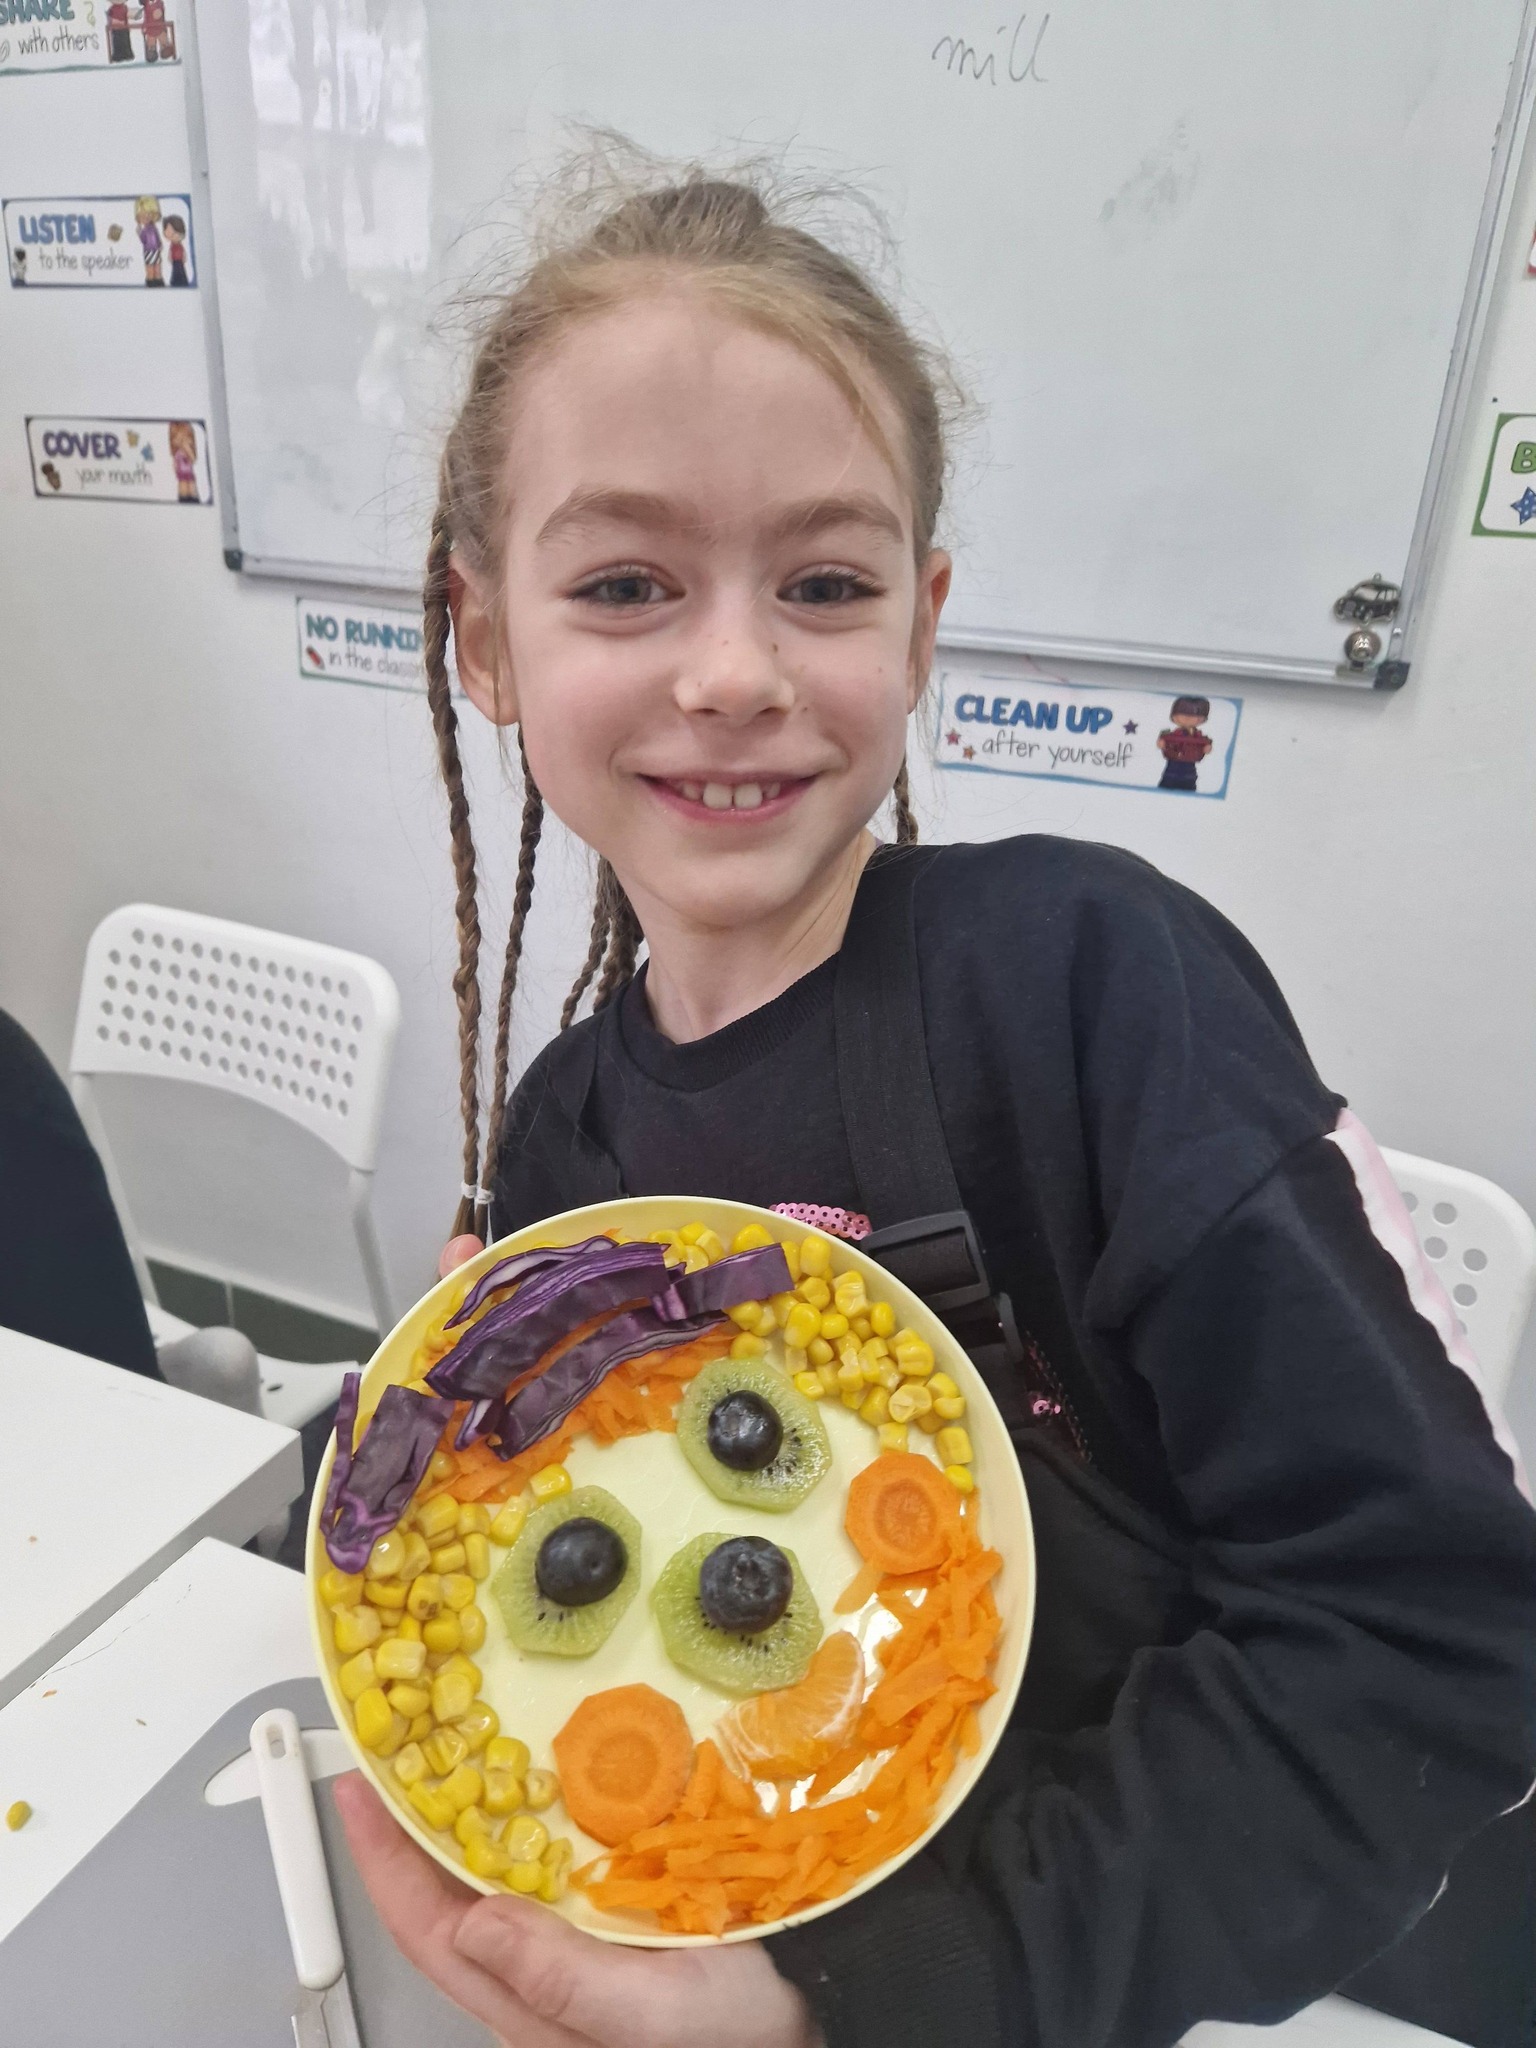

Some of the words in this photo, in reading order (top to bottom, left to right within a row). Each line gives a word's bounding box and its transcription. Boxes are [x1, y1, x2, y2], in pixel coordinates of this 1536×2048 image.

[18, 26, 49, 55] with
[52, 25, 100, 52] others
[19, 213, 97, 244] LISTEN
[39, 247, 53, 270] to
[56, 246, 78, 270] the
[81, 246, 133, 276] speaker
[42, 430, 122, 459] COVER
[76, 468, 105, 490] your
[108, 463, 154, 486] mouth
[305, 613, 339, 641] NO
[328, 650, 342, 667] in
[345, 646, 372, 672] the
[954, 693, 1060, 731] CLEAN
[1065, 705, 1113, 734] UP
[981, 729, 1043, 759] after
[1047, 741, 1134, 770] yourself
